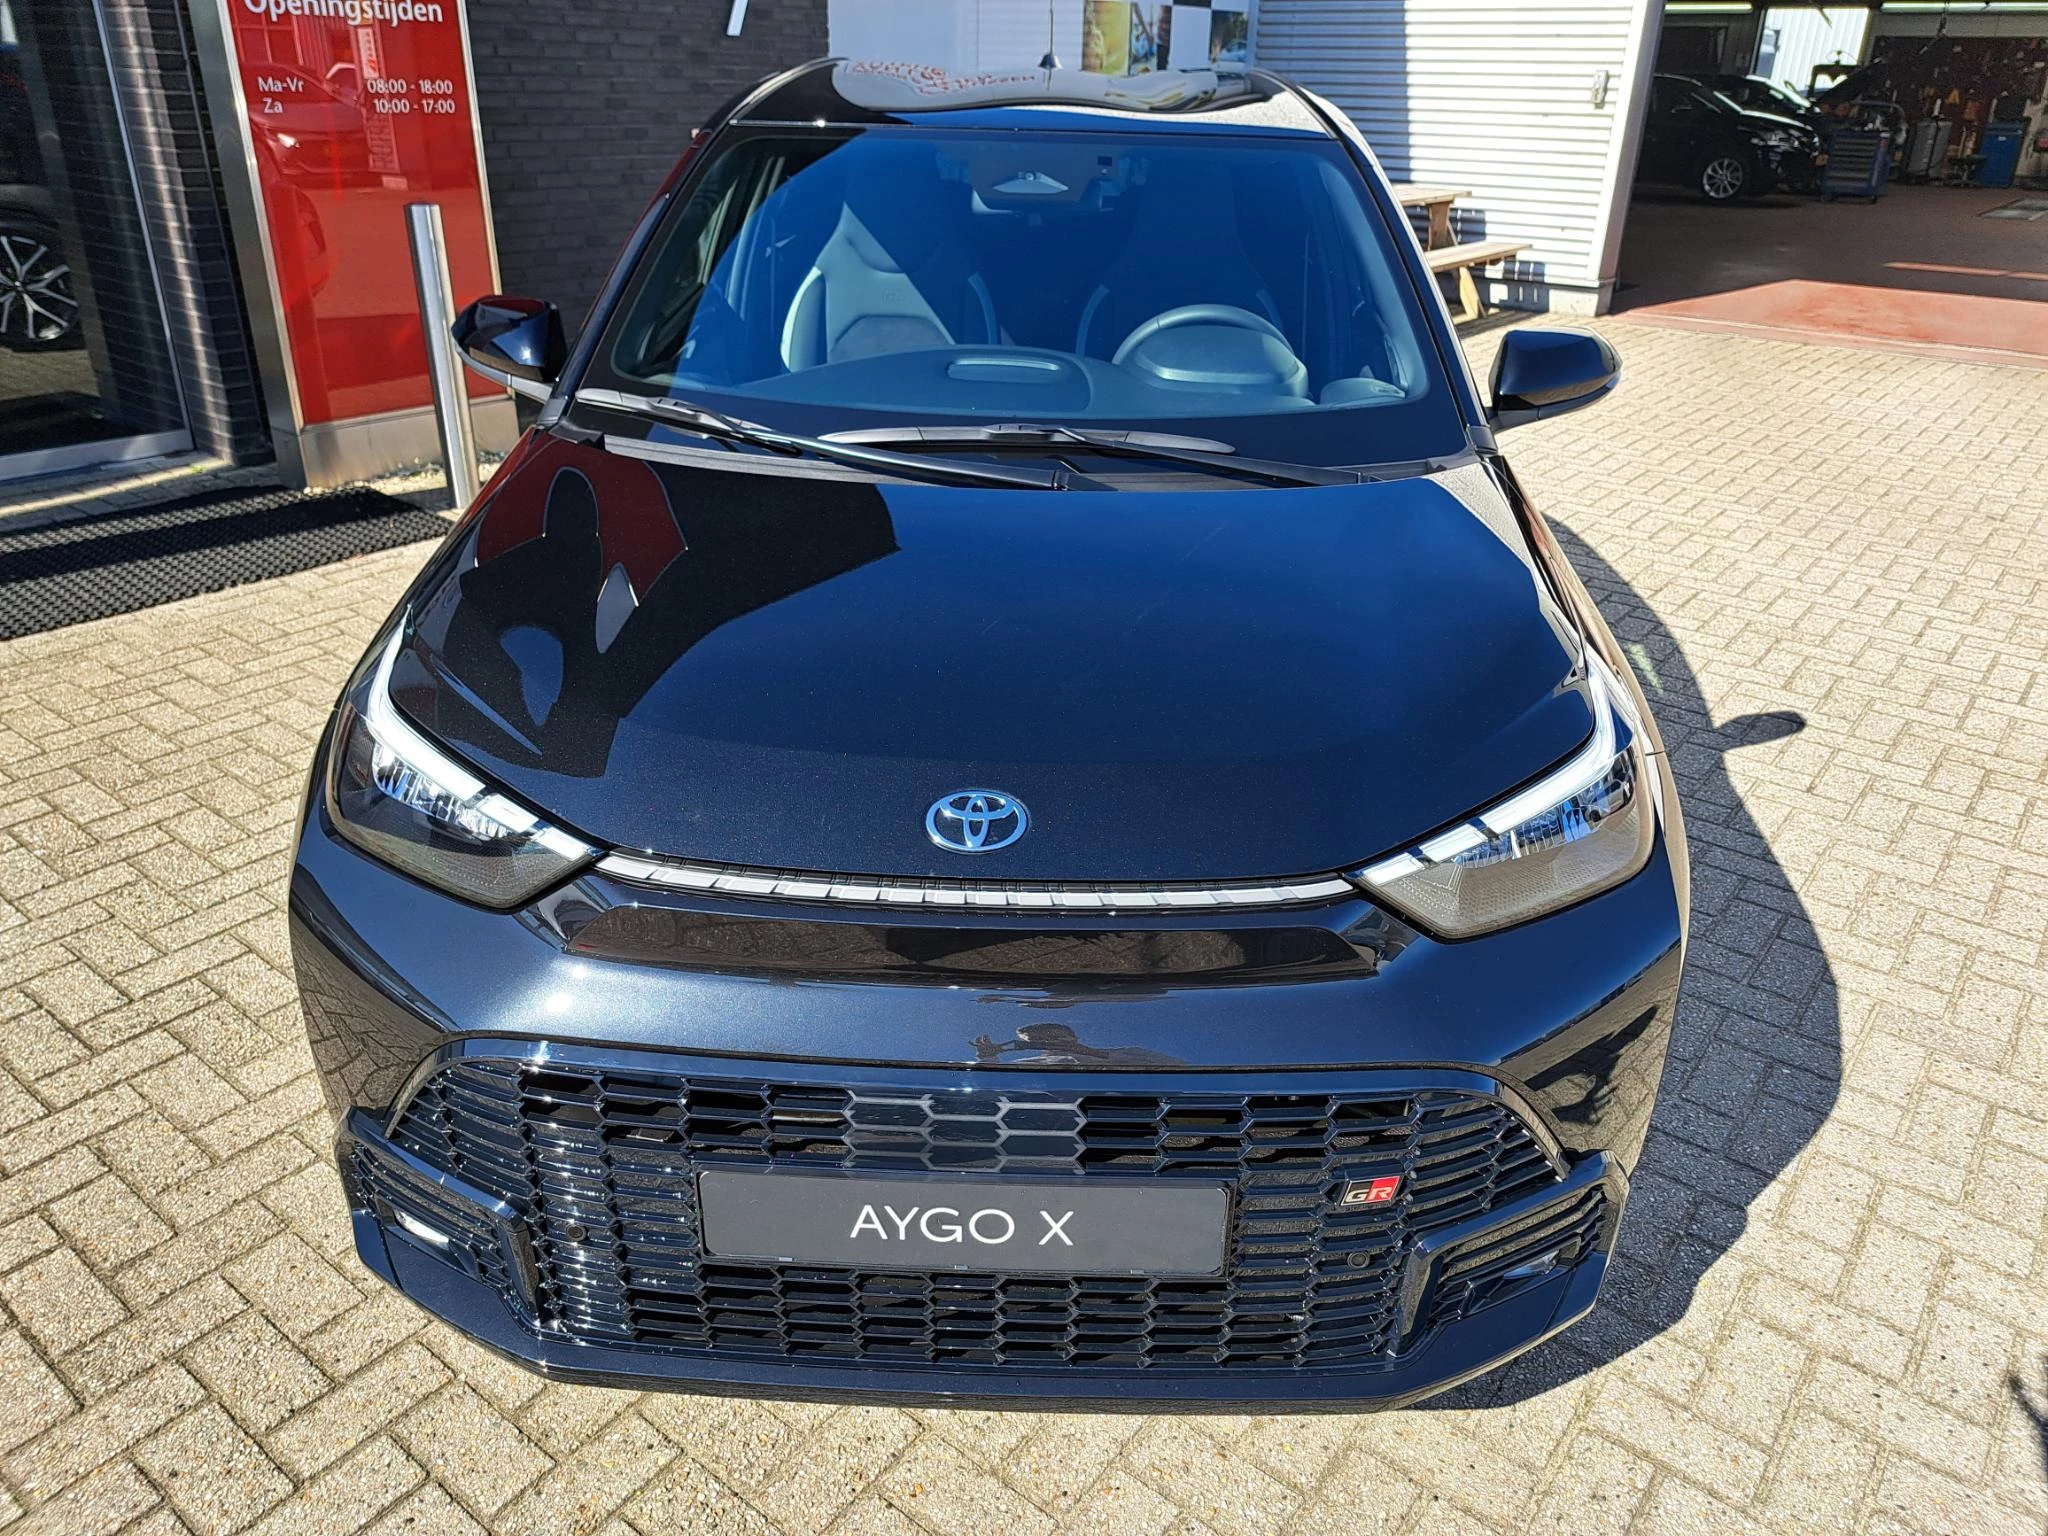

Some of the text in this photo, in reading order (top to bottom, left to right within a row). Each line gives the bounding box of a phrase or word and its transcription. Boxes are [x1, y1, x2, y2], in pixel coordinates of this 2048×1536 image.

[246, 0, 443, 27] Openingstijden
[257, 76, 304, 93] Ma-Vr
[367, 79, 407, 94] 08:00
[419, 79, 453, 95] 18:00
[263, 98, 284, 114] Za
[374, 98, 410, 114] 10:00
[422, 99, 456, 114] 17:00
[1345, 1187, 1393, 1203] GR
[850, 1204, 1075, 1246] AYGO X
